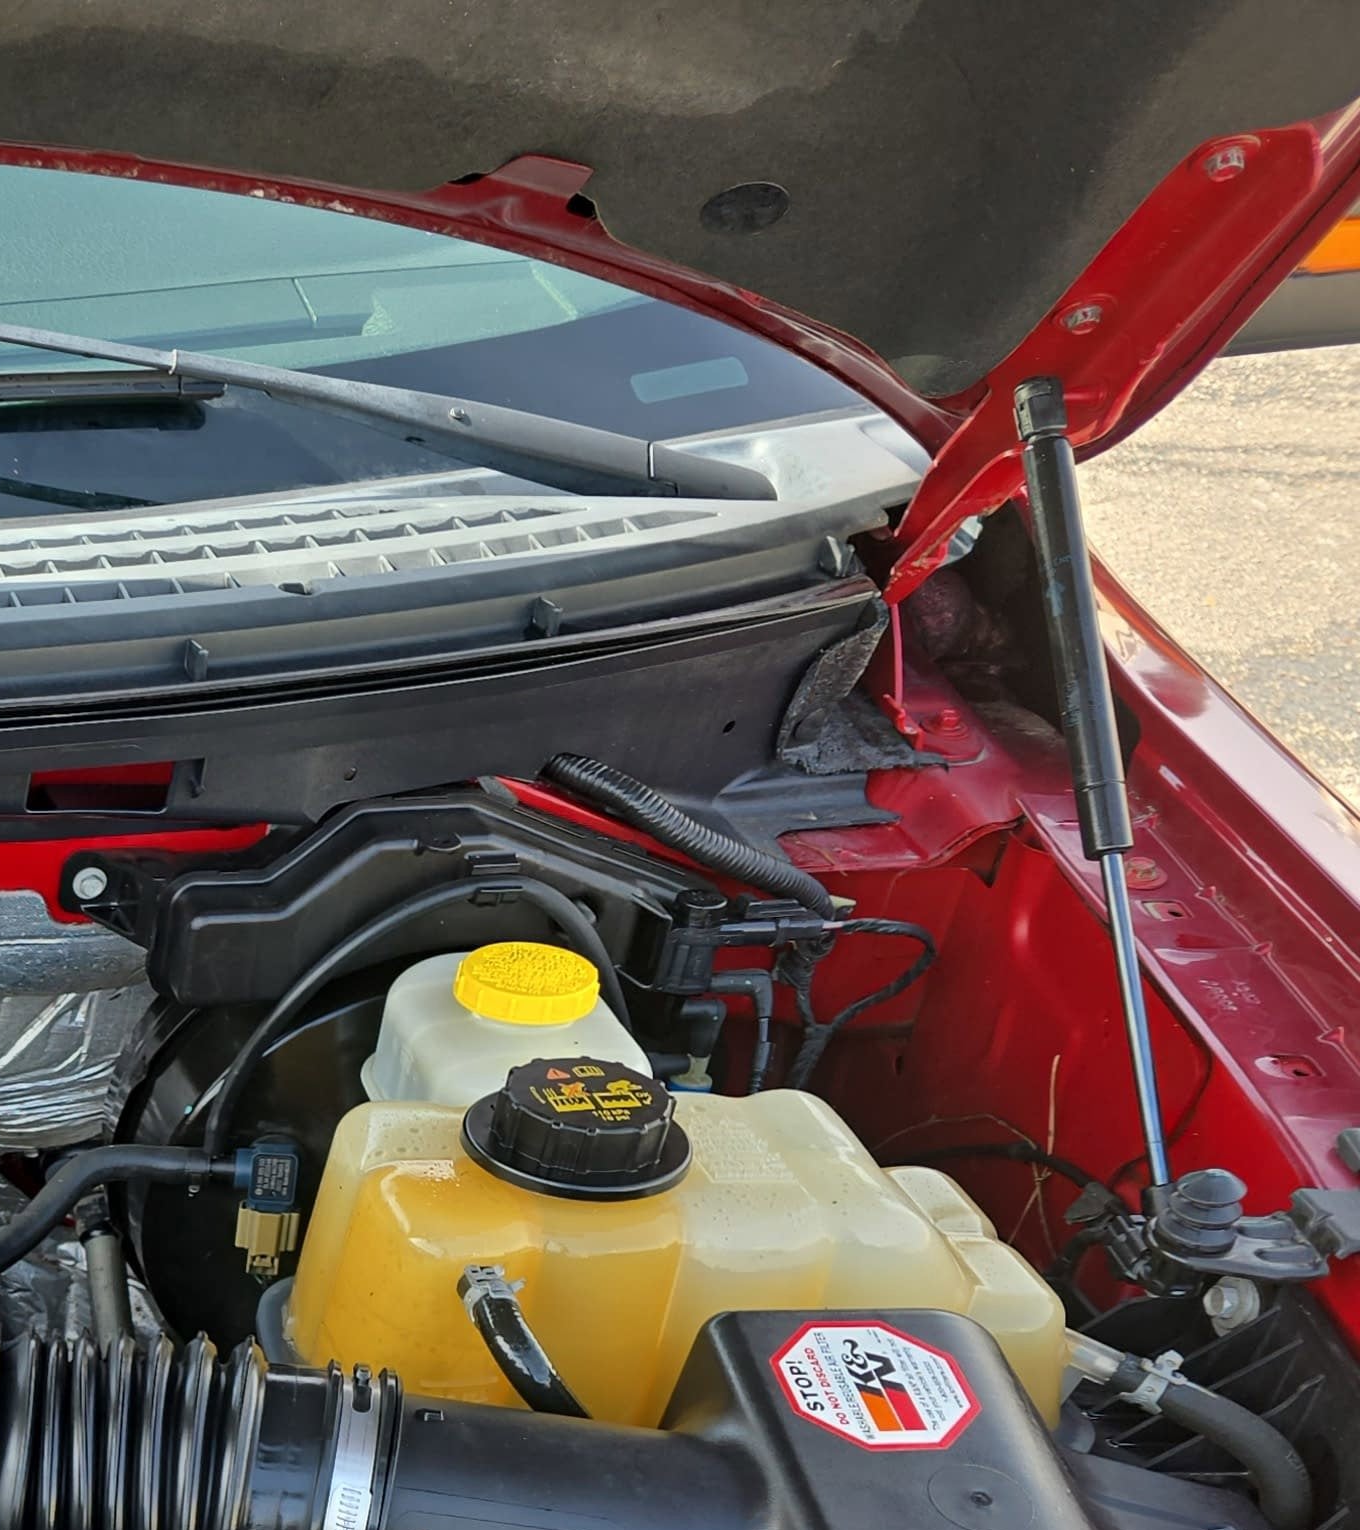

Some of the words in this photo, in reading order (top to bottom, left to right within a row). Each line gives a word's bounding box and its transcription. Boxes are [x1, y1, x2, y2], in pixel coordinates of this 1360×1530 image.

[811, 1331, 833, 1354] FILTER
[802, 1347, 831, 1387] DISCARD
[784, 1359, 826, 1411] STOP!
[823, 1389, 842, 1409] NOT
[834, 1412, 850, 1425] DO
